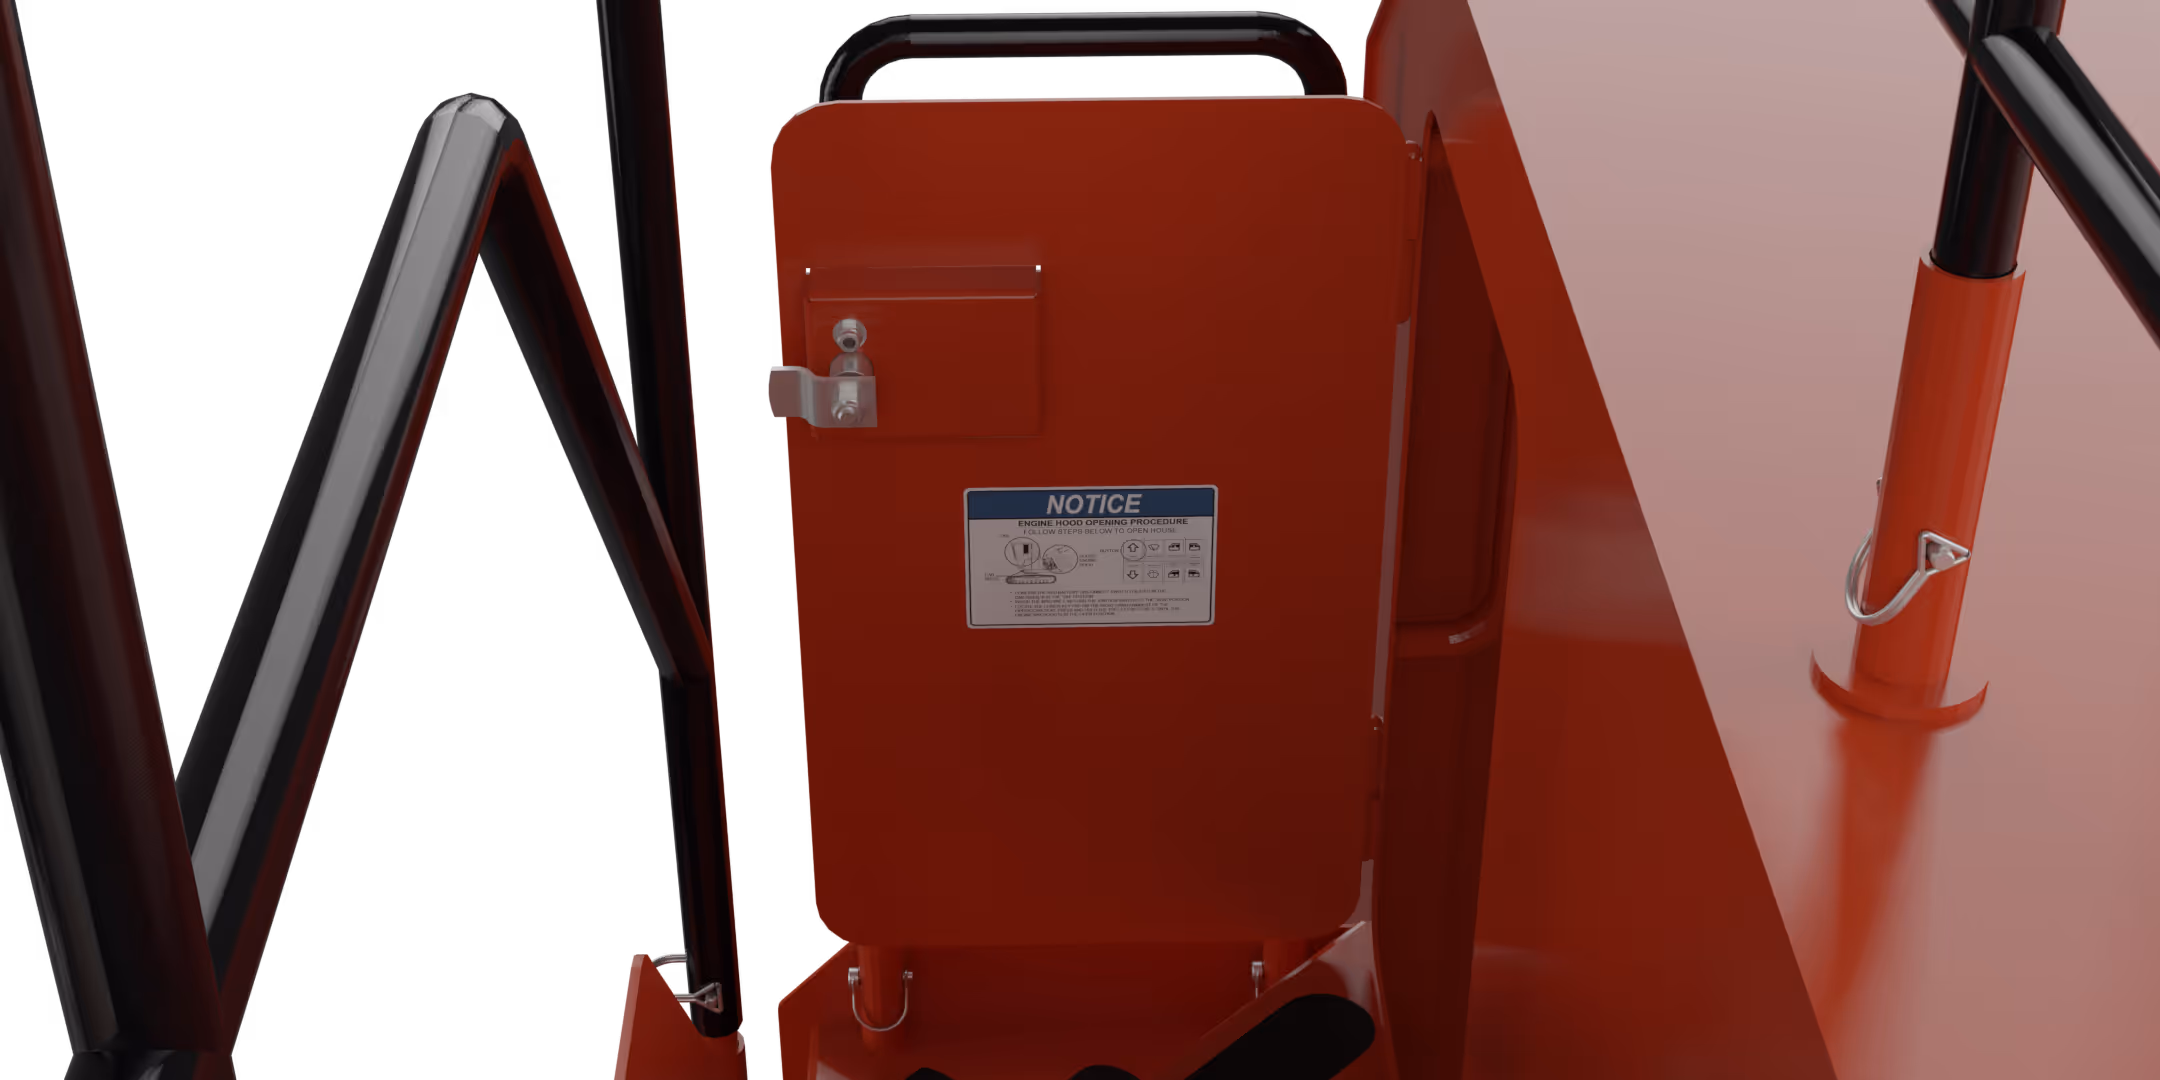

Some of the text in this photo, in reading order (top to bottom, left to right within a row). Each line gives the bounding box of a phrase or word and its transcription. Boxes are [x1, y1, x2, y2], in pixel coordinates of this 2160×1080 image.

[1046, 493, 1143, 515] NOTICE
[1018, 518, 1189, 528] ENGINE HOOD OPENING PROCEDURE
[1023, 528, 1057, 536] FOLLOW
[1150, 526, 1177, 534] HOUSE
